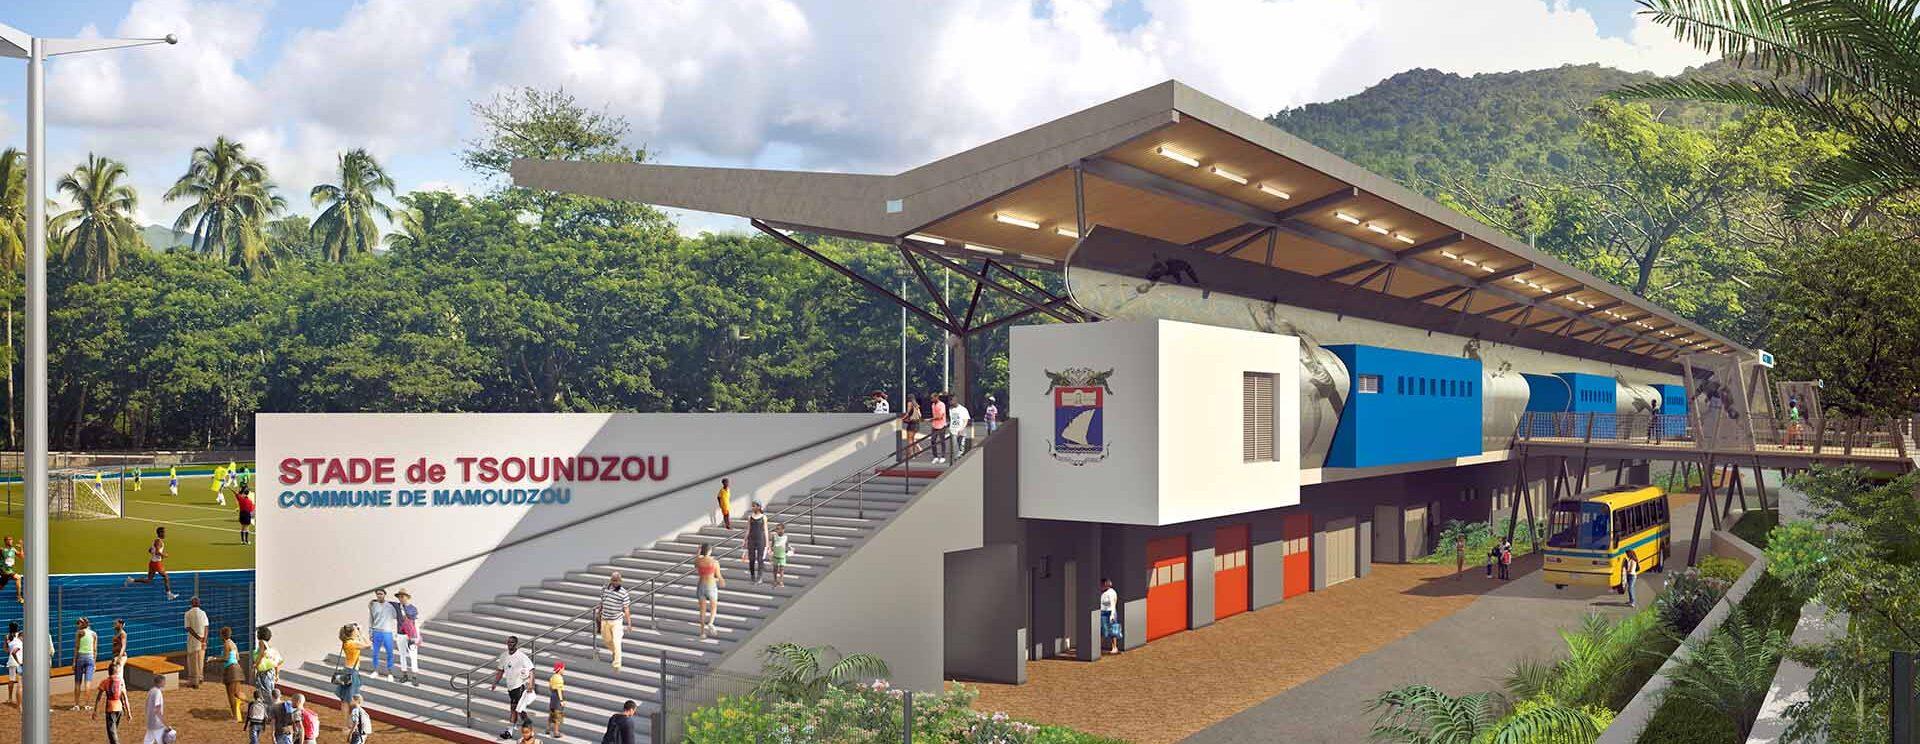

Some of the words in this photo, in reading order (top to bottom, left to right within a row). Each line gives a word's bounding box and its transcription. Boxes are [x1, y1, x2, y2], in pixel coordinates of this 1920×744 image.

[279, 457, 396, 485] STADE
[406, 457, 446, 484] de
[456, 455, 669, 483] TSOUNDZOU
[278, 490, 392, 508] COMMUNE
[397, 490, 427, 507] DE
[433, 488, 571, 505] MAMOUDZOU
